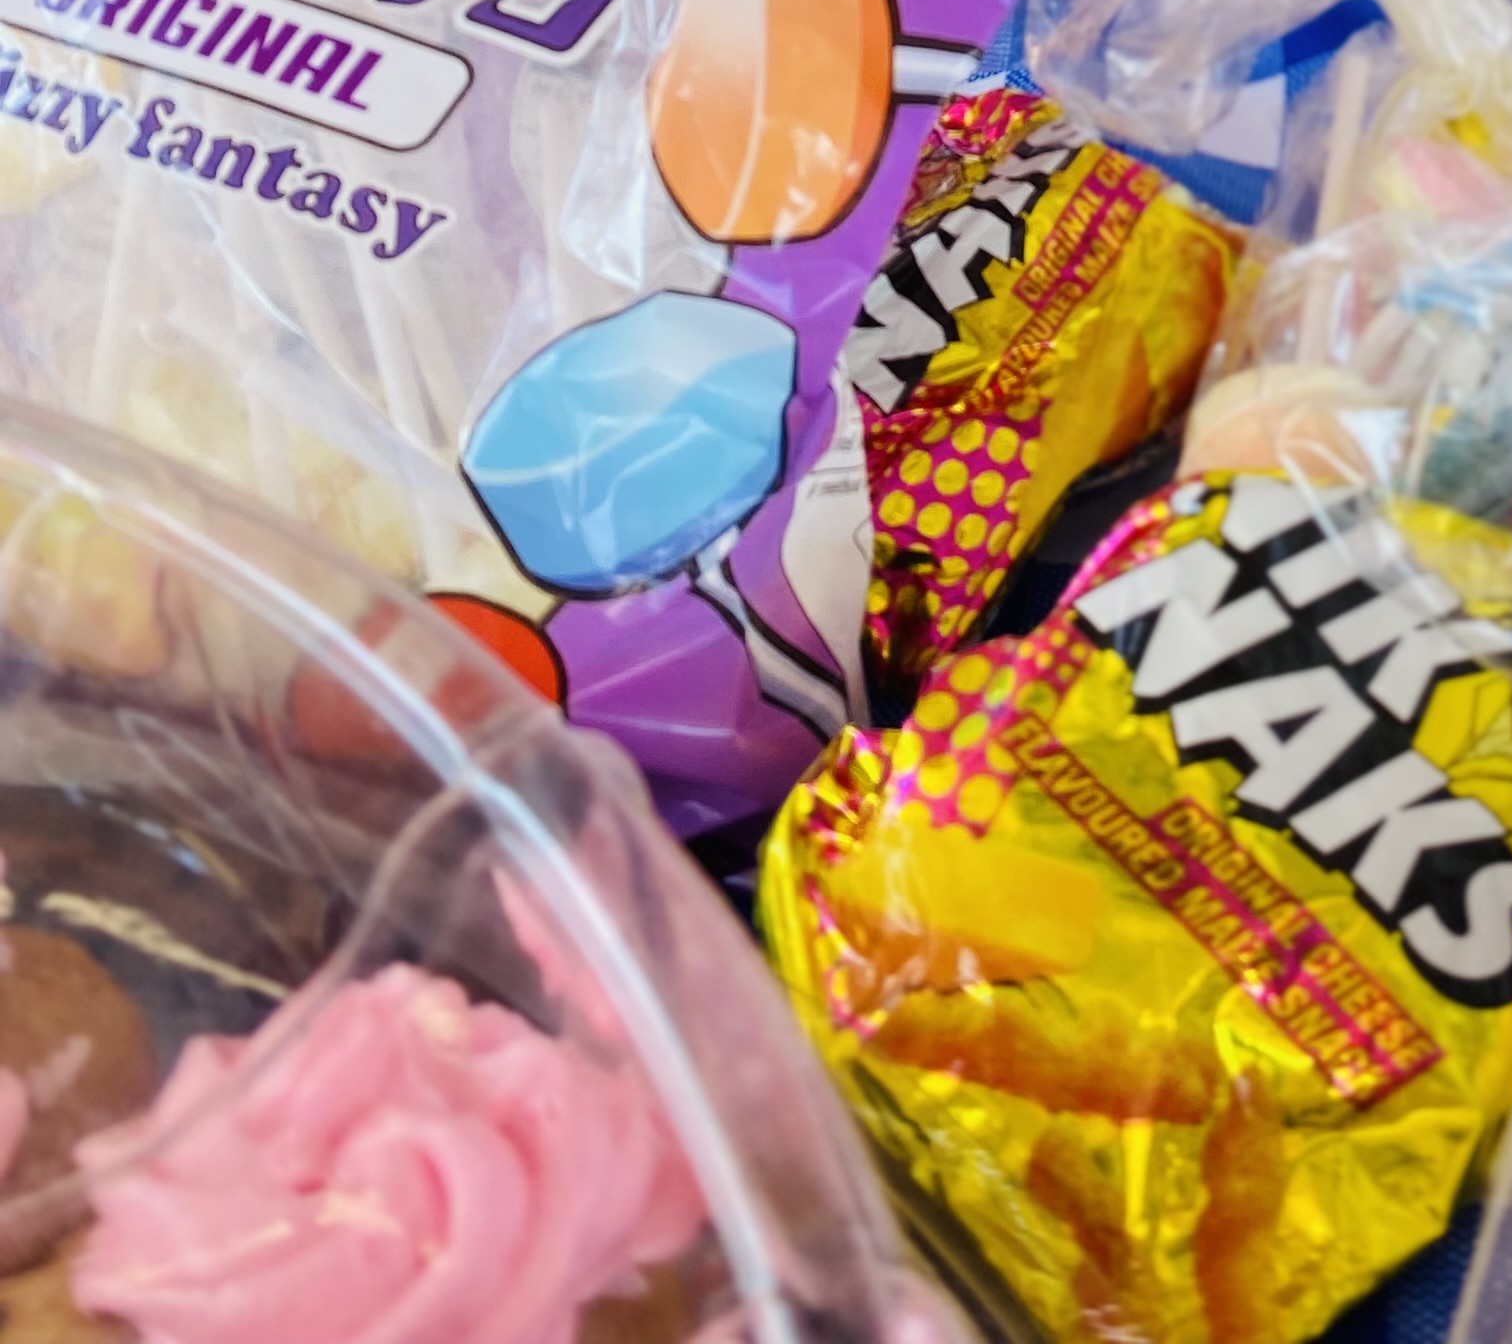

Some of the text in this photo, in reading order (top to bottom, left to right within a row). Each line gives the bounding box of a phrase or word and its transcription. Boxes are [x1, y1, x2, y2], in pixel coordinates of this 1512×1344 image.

[0, 49, 448, 260] izzy fantasy
[1018, 185, 1106, 302] ORIGINAL
[1001, 716, 1185, 891] FLAVOURED
[1301, 943, 1437, 1070] CHEESE
